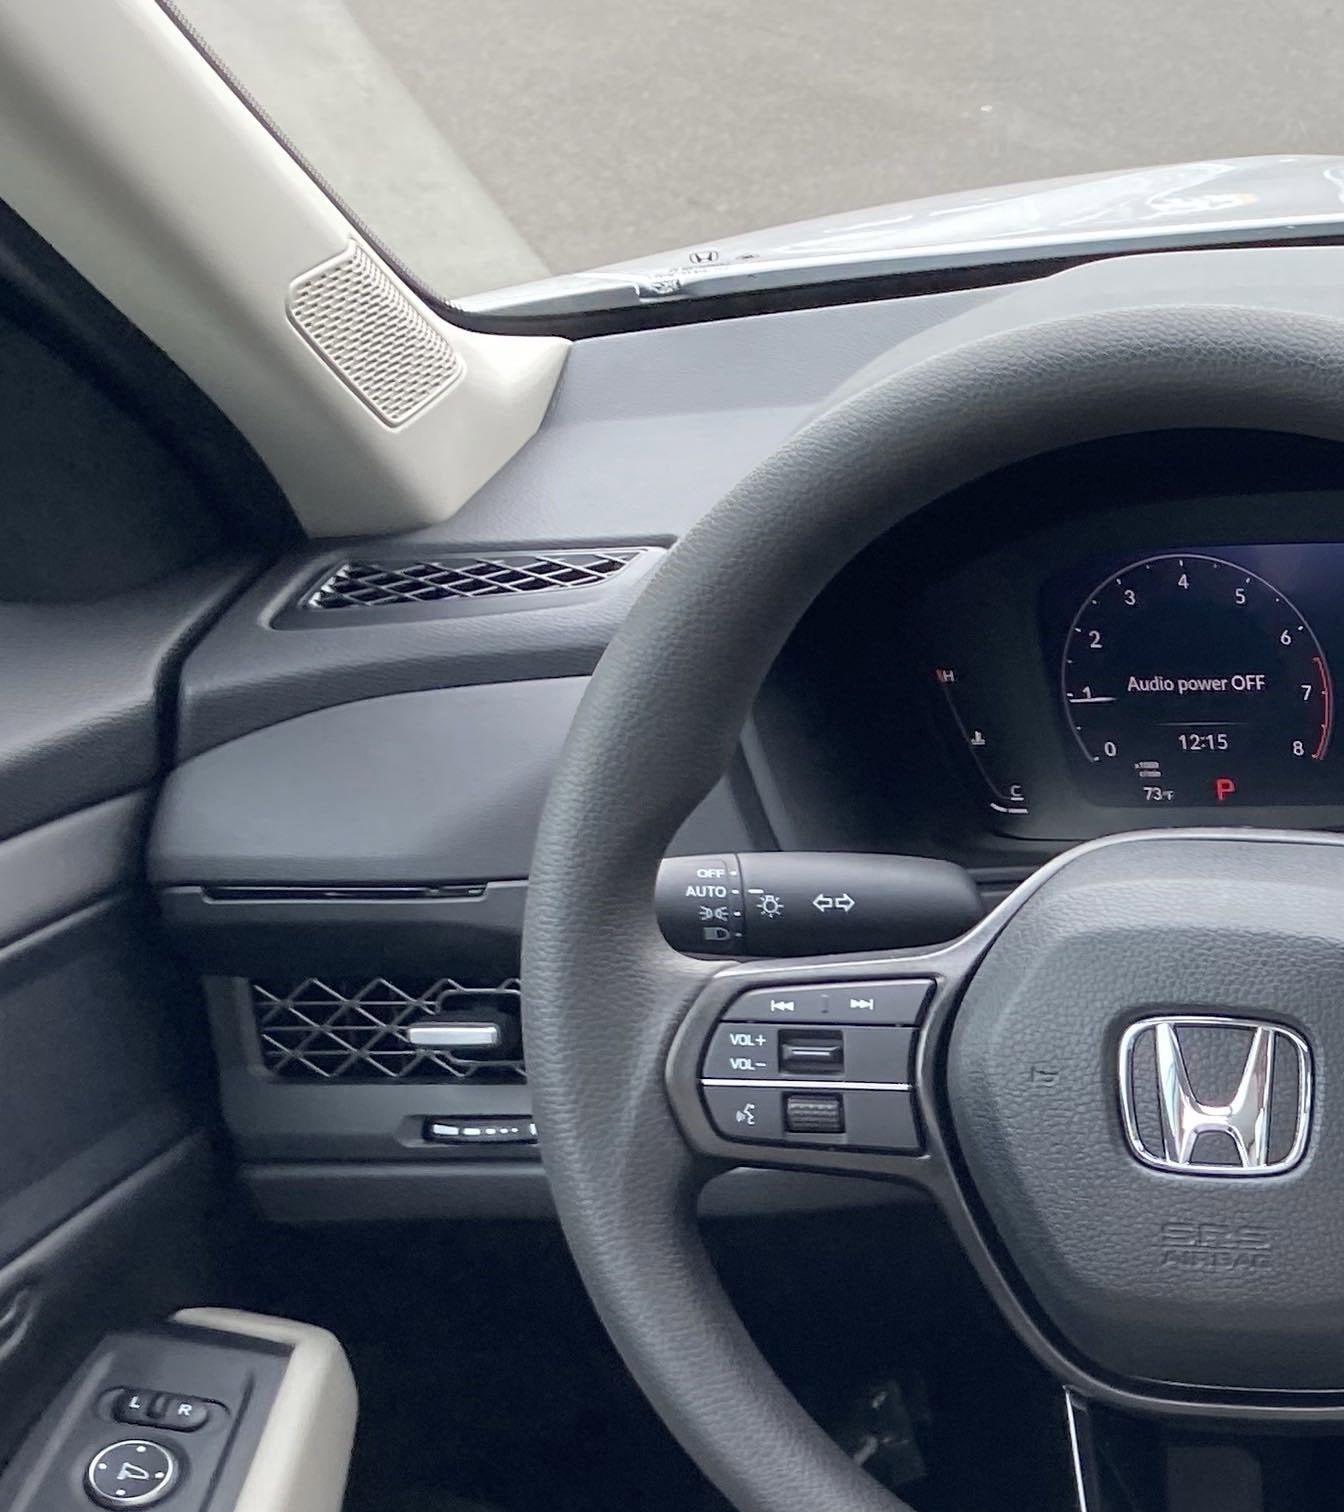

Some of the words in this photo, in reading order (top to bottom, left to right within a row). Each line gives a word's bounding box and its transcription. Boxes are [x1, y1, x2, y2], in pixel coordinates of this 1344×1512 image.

[1177, 572, 1190, 590] 4
[1123, 589, 1137, 606] 3
[1234, 588, 1246, 606] 5
[1089, 630, 1103, 649] 2
[1279, 629, 1292, 647] 6
[1126, 675, 1175, 693] Audio
[1177, 677, 1229, 696] power
[1230, 674, 1267, 691] OFF
[1300, 684, 1312, 701] 7
[1104, 740, 1117, 759] 0
[1177, 732, 1230, 752] 12:15
[1292, 739, 1305, 758] 8
[1215, 777, 1237, 802] P
[696, 868, 726, 879] OFF
[685, 885, 728, 898] AUTO
[128, 1395, 141, 1410] L
[177, 1402, 193, 1417] R
